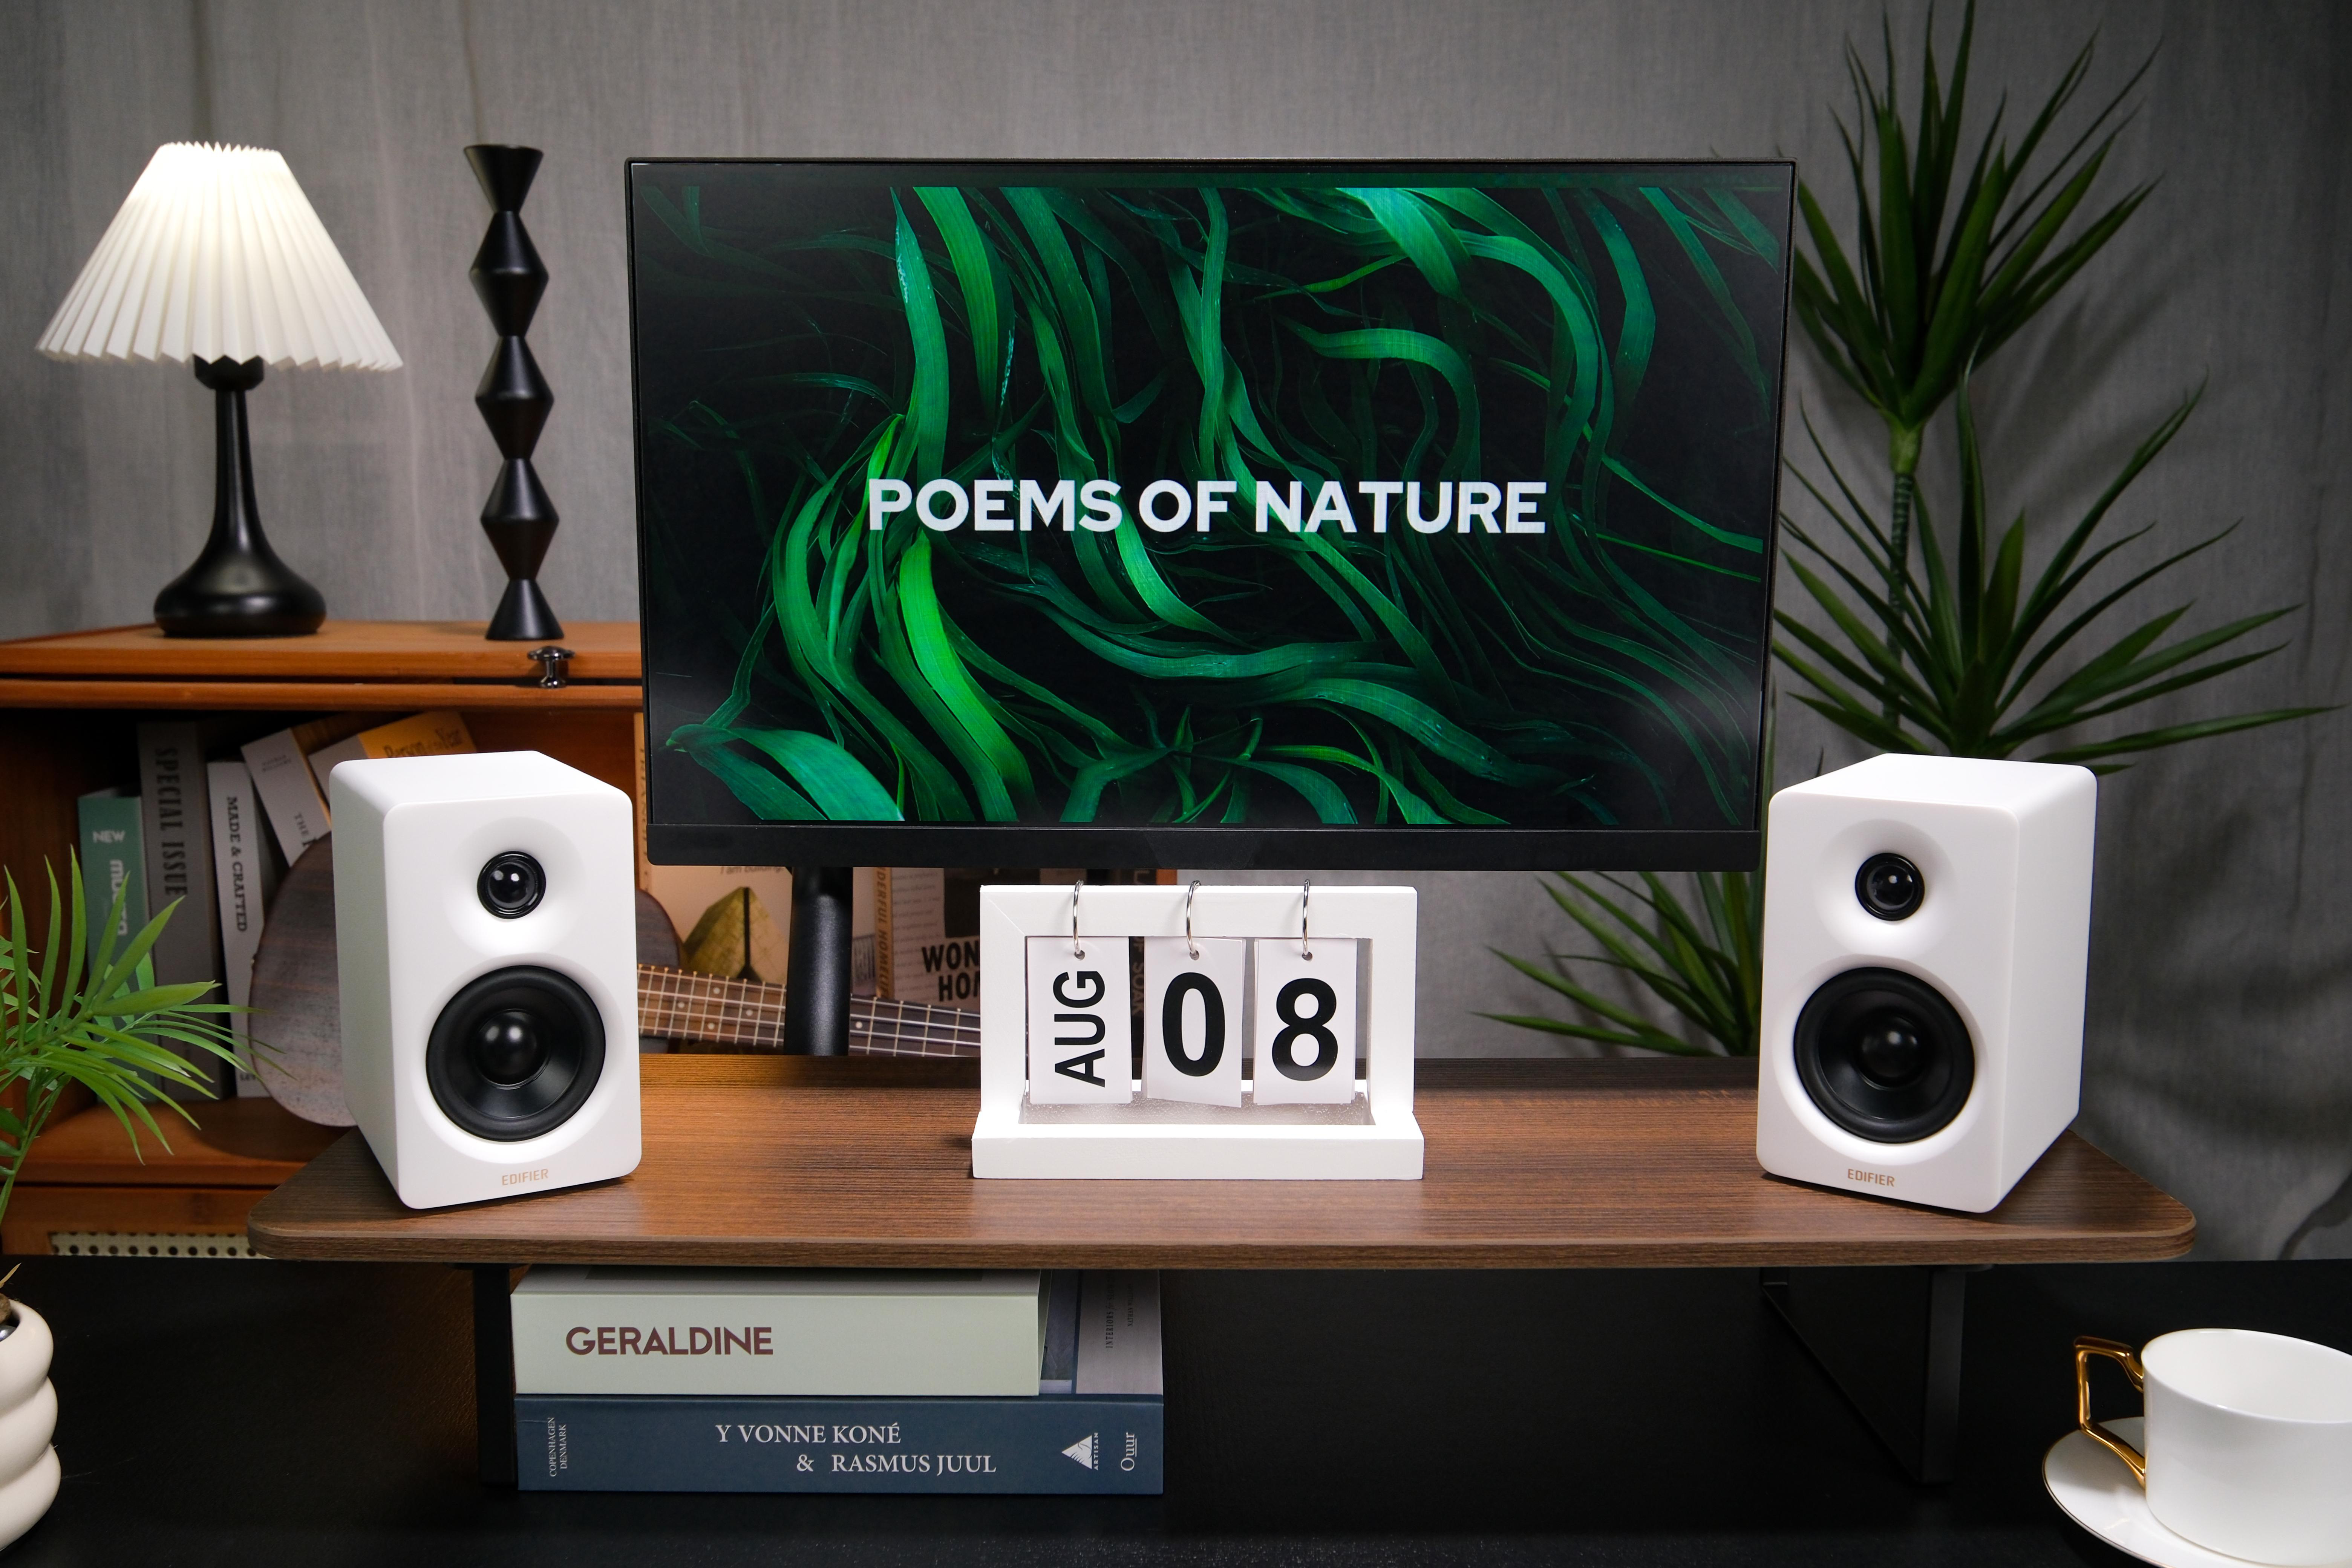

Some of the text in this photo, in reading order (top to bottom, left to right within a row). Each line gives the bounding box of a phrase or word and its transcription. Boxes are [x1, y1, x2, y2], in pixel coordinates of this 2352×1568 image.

[868, 479, 1547, 534] POEMS OF NATURE
[93, 830, 125, 844] NEW
[155, 748, 188, 896] SPECIAL ISSUE
[227, 796, 248, 933] MADE & CRAFTED
[922, 940, 980, 973] WON
[1053, 971, 1106, 1088] AUG
[502, 1169, 549, 1186] EDIFIER
[1848, 1168, 1895, 1187] EDIFIER
[566, 1326, 774, 1356] GERALDINE
[1106, 1311, 1114, 1348] INTERIORS
[548, 1417, 557, 1477] COPENHAGEN
[559, 1424, 568, 1470] DENMARK
[832, 1422, 901, 1444] KONÉ
[796, 1454, 997, 1476] & RASMUS JUUL
